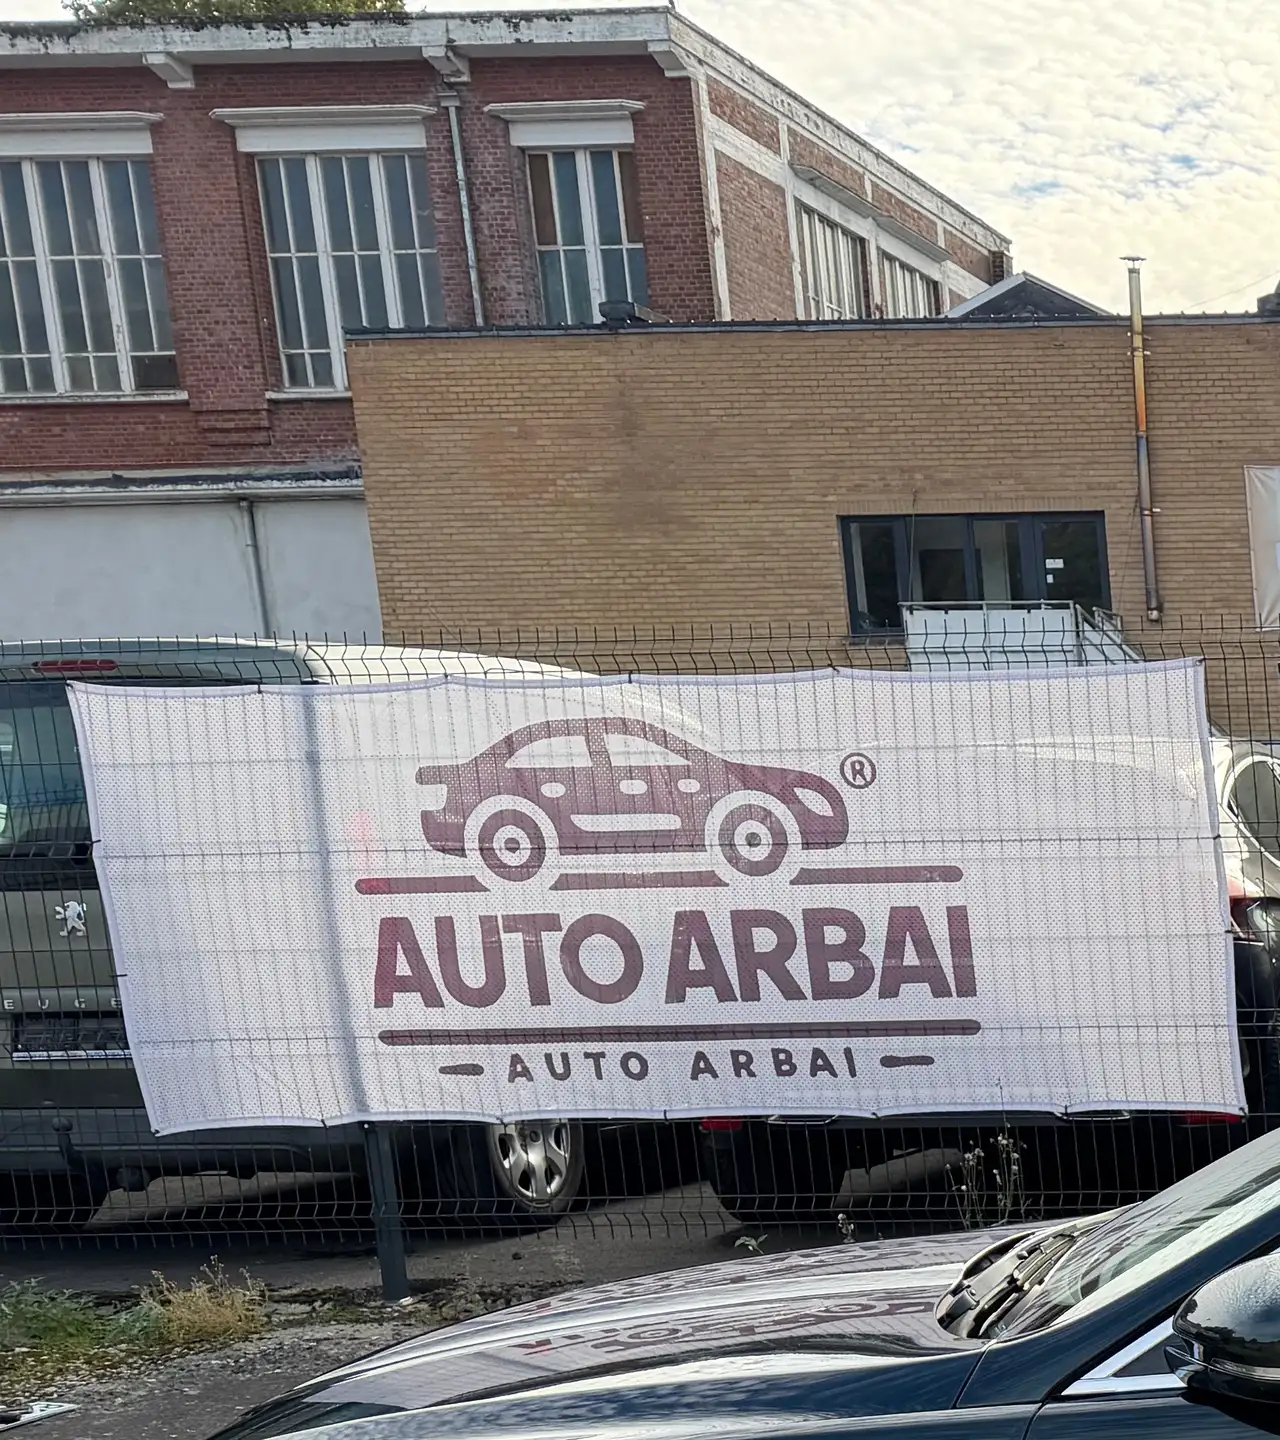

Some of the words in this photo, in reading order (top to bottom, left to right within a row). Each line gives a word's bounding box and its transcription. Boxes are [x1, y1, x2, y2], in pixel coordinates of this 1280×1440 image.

[373, 913, 645, 1008] AUTO
[664, 905, 978, 1004] ARBAI
[508, 1050, 649, 1083] AUTO
[689, 1046, 858, 1081] ARBAI
